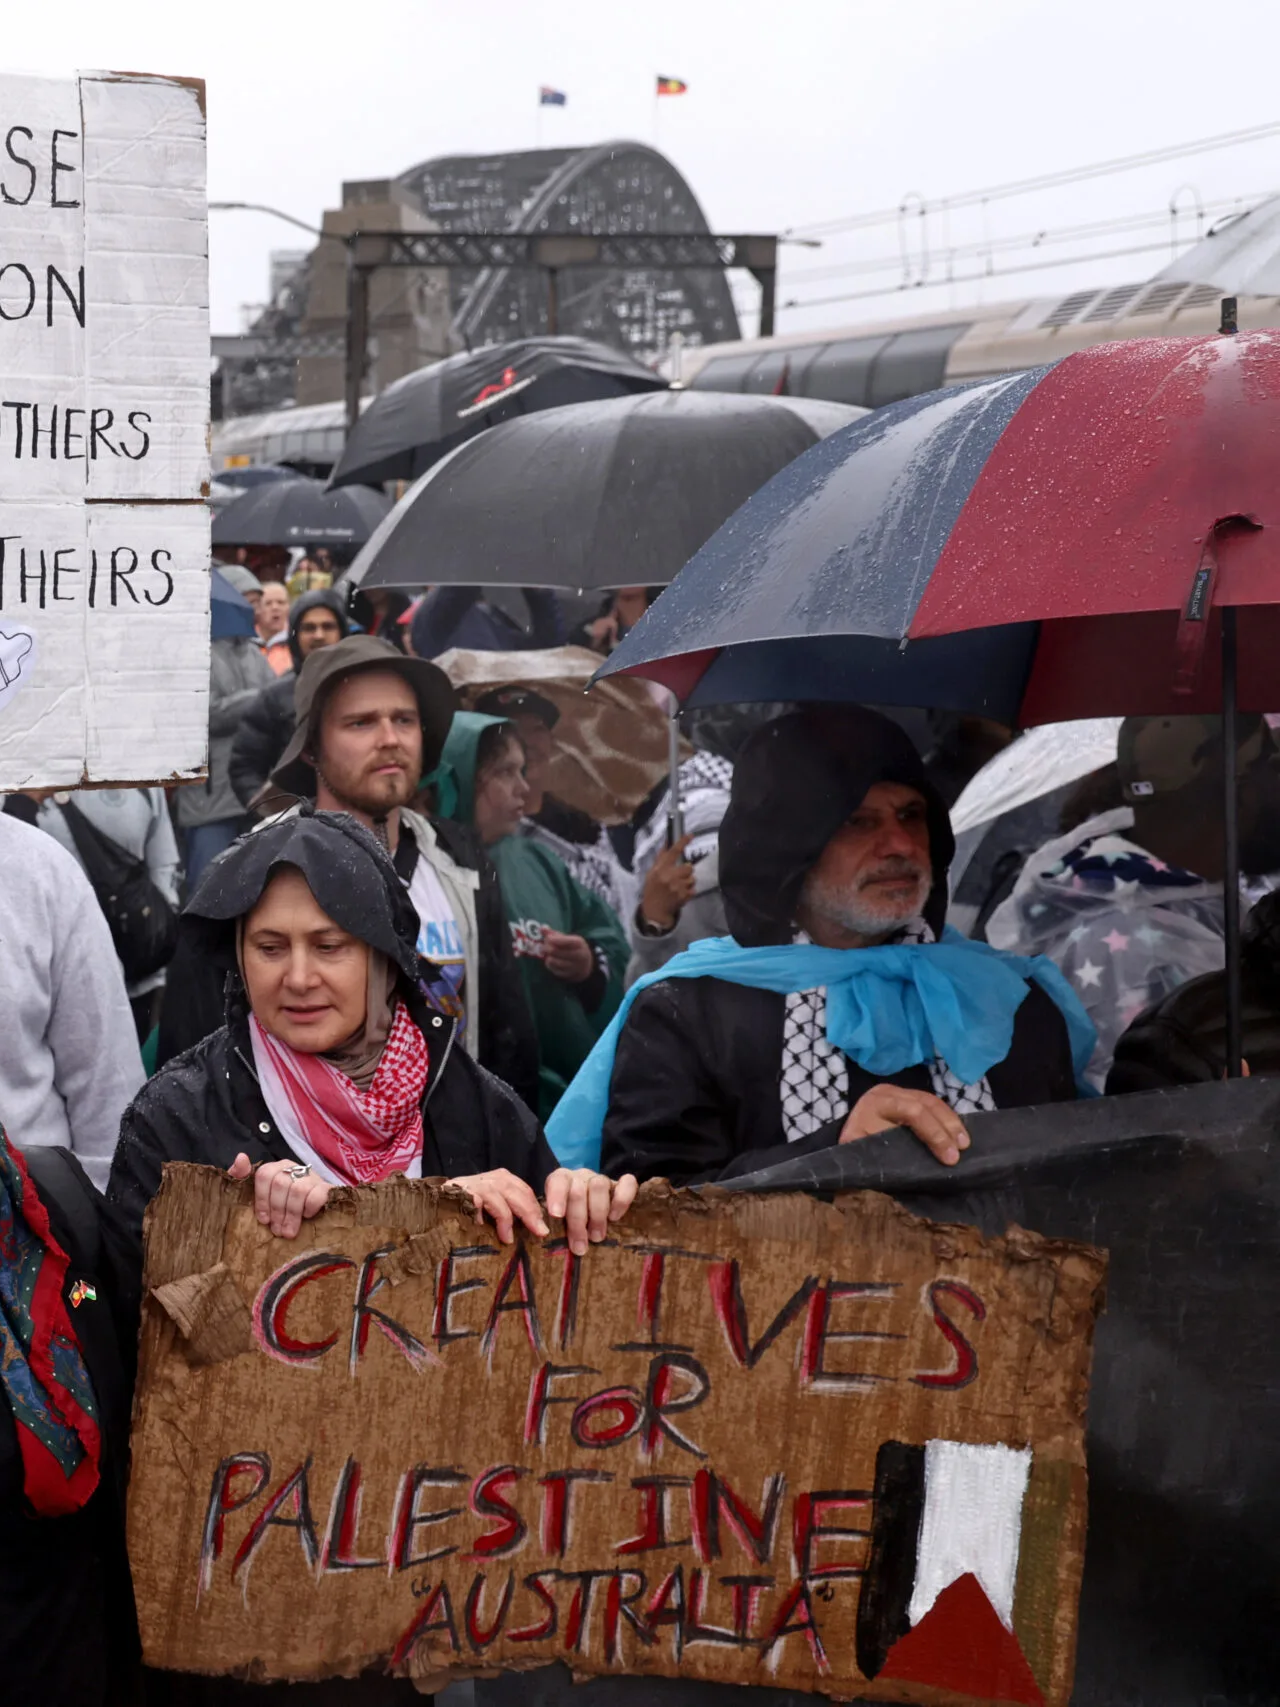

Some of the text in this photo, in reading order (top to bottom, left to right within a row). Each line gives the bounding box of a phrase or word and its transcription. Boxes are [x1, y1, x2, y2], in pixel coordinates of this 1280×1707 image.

[251, 1238, 987, 1398] CREATIVES
[523, 1349, 711, 1463] FOR
[200, 1449, 877, 1600] PALESTINE
